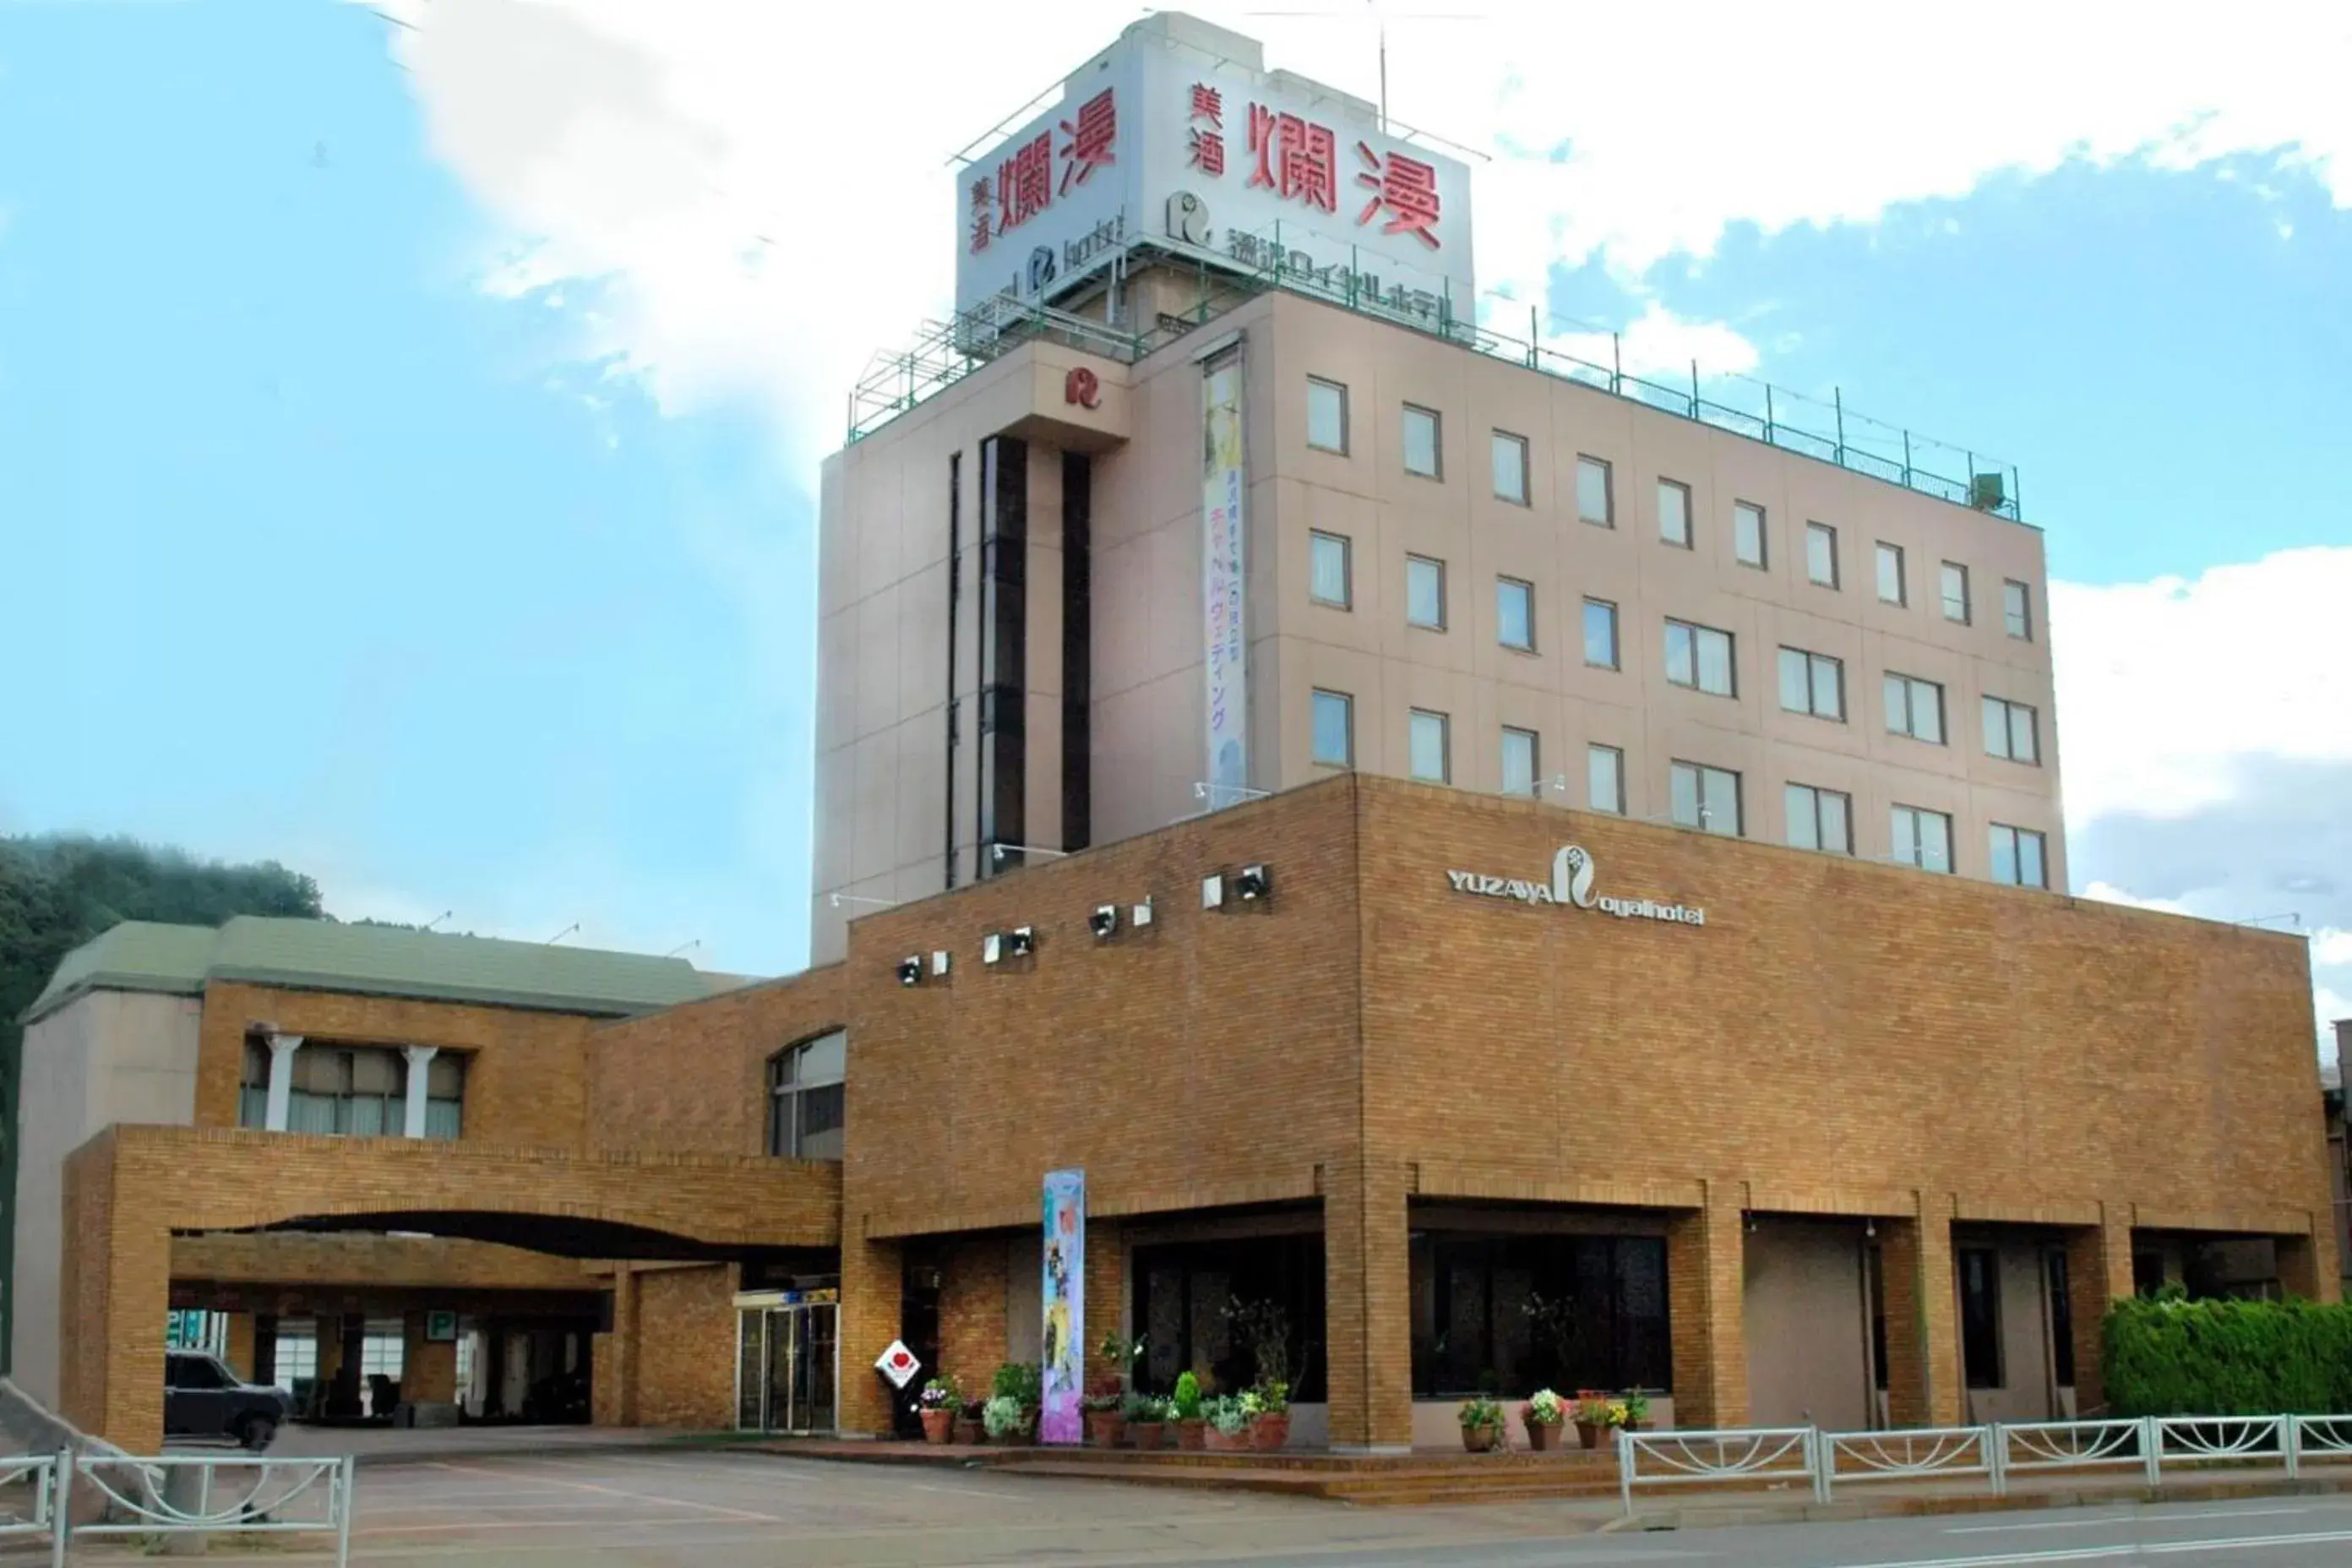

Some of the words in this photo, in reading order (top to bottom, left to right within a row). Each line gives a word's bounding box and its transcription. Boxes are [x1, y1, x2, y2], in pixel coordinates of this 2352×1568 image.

[997, 85, 1117, 239] 爛漫
[1190, 82, 1224, 176] 美酒
[1245, 100, 1442, 249] 爛漫
[432, 1313, 452, 1337] P
